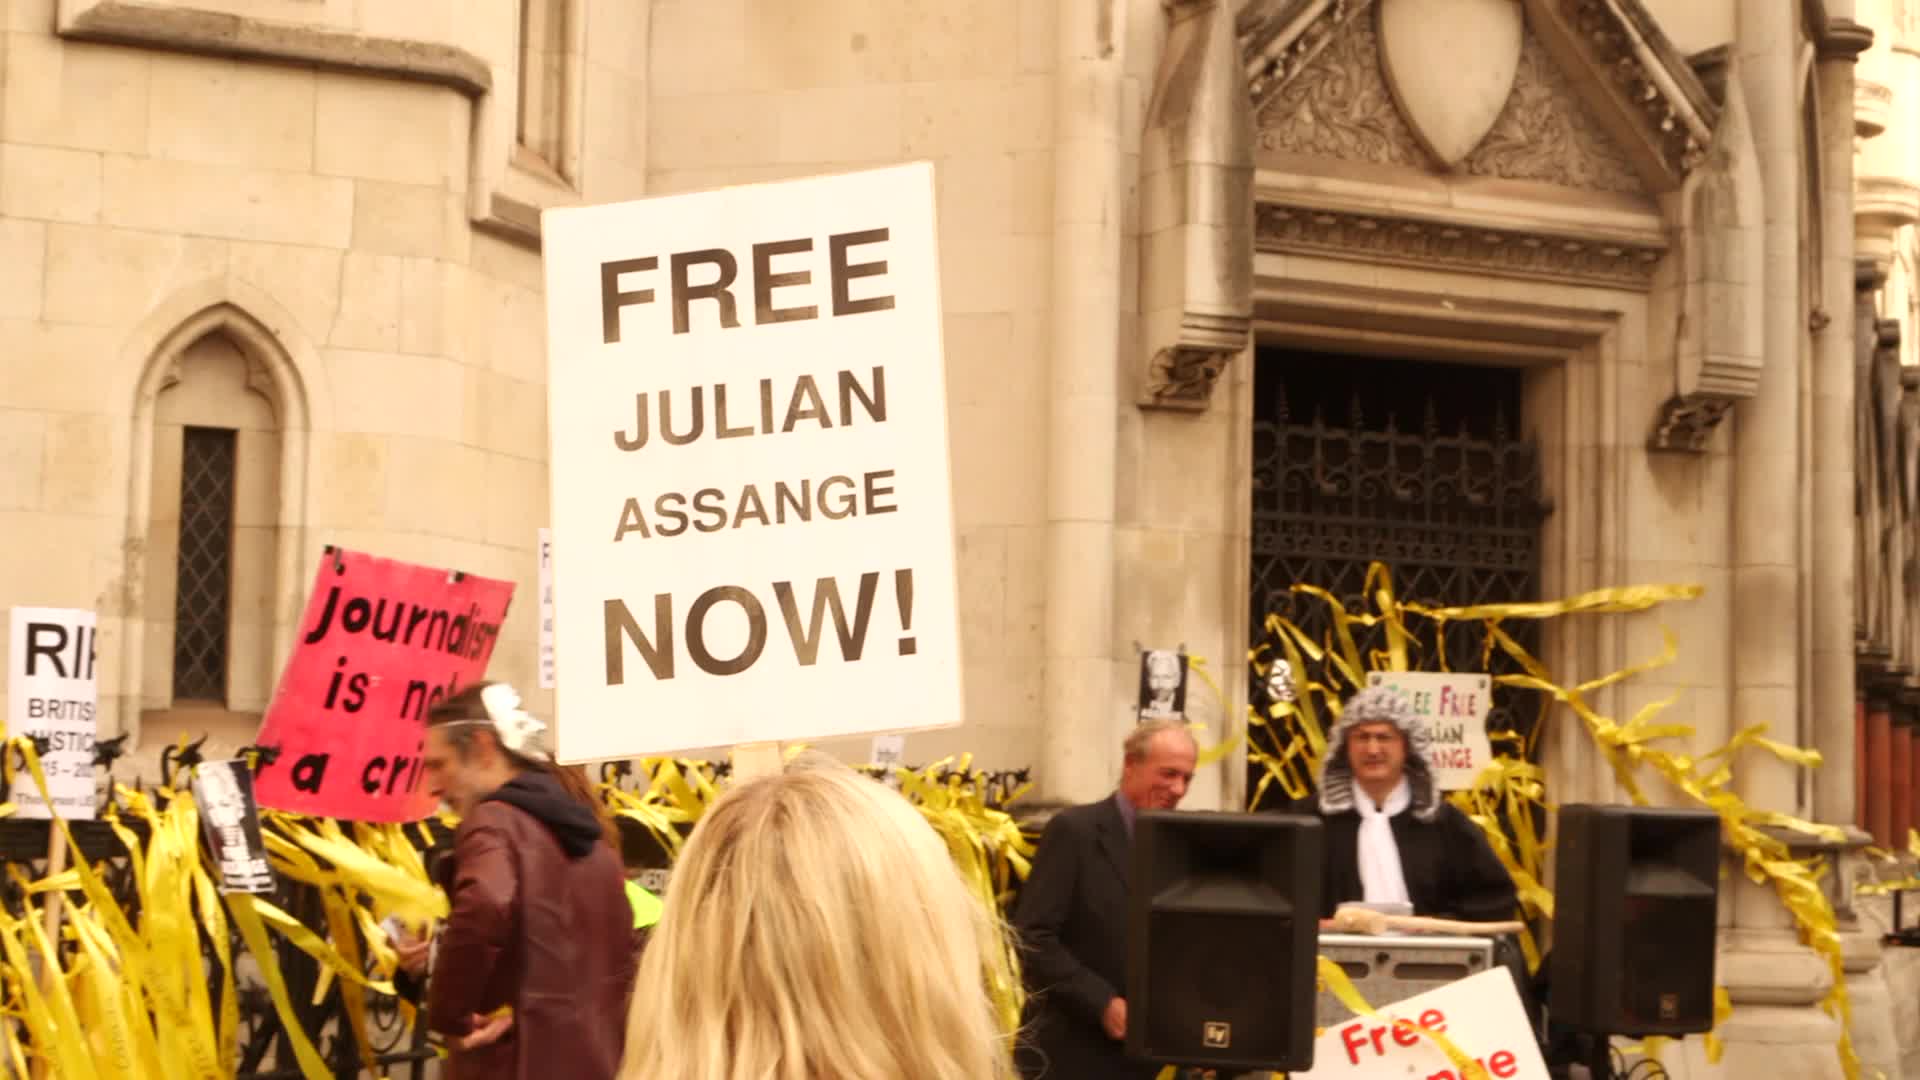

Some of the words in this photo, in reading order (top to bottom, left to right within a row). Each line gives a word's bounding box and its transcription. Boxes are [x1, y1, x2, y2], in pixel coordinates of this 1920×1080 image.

[601, 228, 896, 343] FREE
[614, 365, 887, 452] JULIAN
[614, 470, 898, 542] ASSANGE
[304, 562, 500, 662] journalism
[604, 568, 917, 686] NOW!
[323, 656, 369, 713] is
[290, 753, 331, 795] a
[1341, 1008, 1449, 1066] Free
